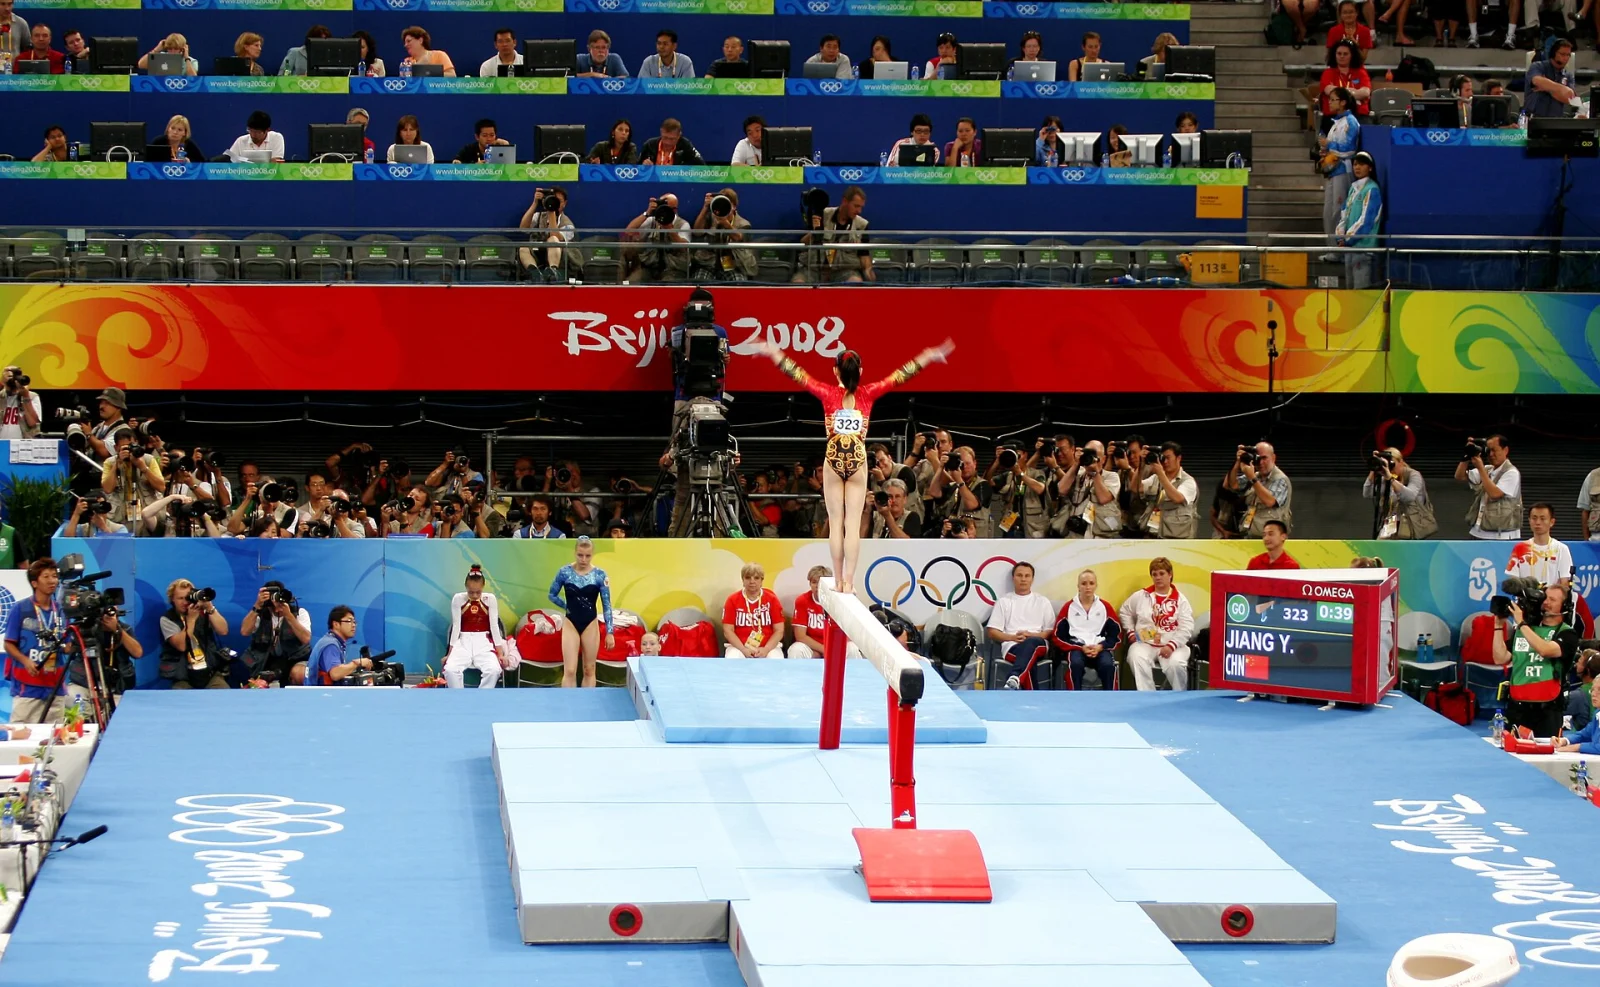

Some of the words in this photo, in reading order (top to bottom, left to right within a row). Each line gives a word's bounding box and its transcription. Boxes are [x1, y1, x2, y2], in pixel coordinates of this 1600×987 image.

[641, 1, 704, 9] www.beijing2008.cn
[1059, 6, 1121, 14] www.beijing2008.cn
[210, 80, 276, 88] www.beijing2008.cn
[429, 81, 494, 89] www.beijing2008.cn
[647, 82, 712, 90] www.beijing2008.cn
[1079, 86, 1144, 94] www.beijing2008.cn
[0, 165, 51, 174] .beijing2008.cn
[209, 167, 277, 175] www.beijing2008.cn
[435, 168, 503, 176] www.beijing2008.cn
[661, 169, 729, 177] www.beijing2008.cn
[885, 171, 952, 179] www.beijing2008.cn
[1108, 171, 1174, 180] www.beijing2008.cn
[1199, 263, 1219, 274] 113
[547, 308, 669, 368] Beiji
[729, 316, 847, 358] 2008
[836, 418, 860, 431] 323
[1314, 585, 1355, 599] OMEGA
[1231, 603, 1246, 615] GO
[1283, 608, 1309, 621] 323
[1319, 605, 1353, 621] 0:39
[1226, 630, 1275, 652] JIANG
[1279, 634, 1295, 654] Y.
[1528, 652, 1544, 663] 14
[1226, 653, 1245, 677] CHN
[1525, 665, 1543, 677] RT
[1371, 793, 1530, 854] Beijing
[191, 849, 305, 898] 2008
[148, 901, 332, 982] Beijing
